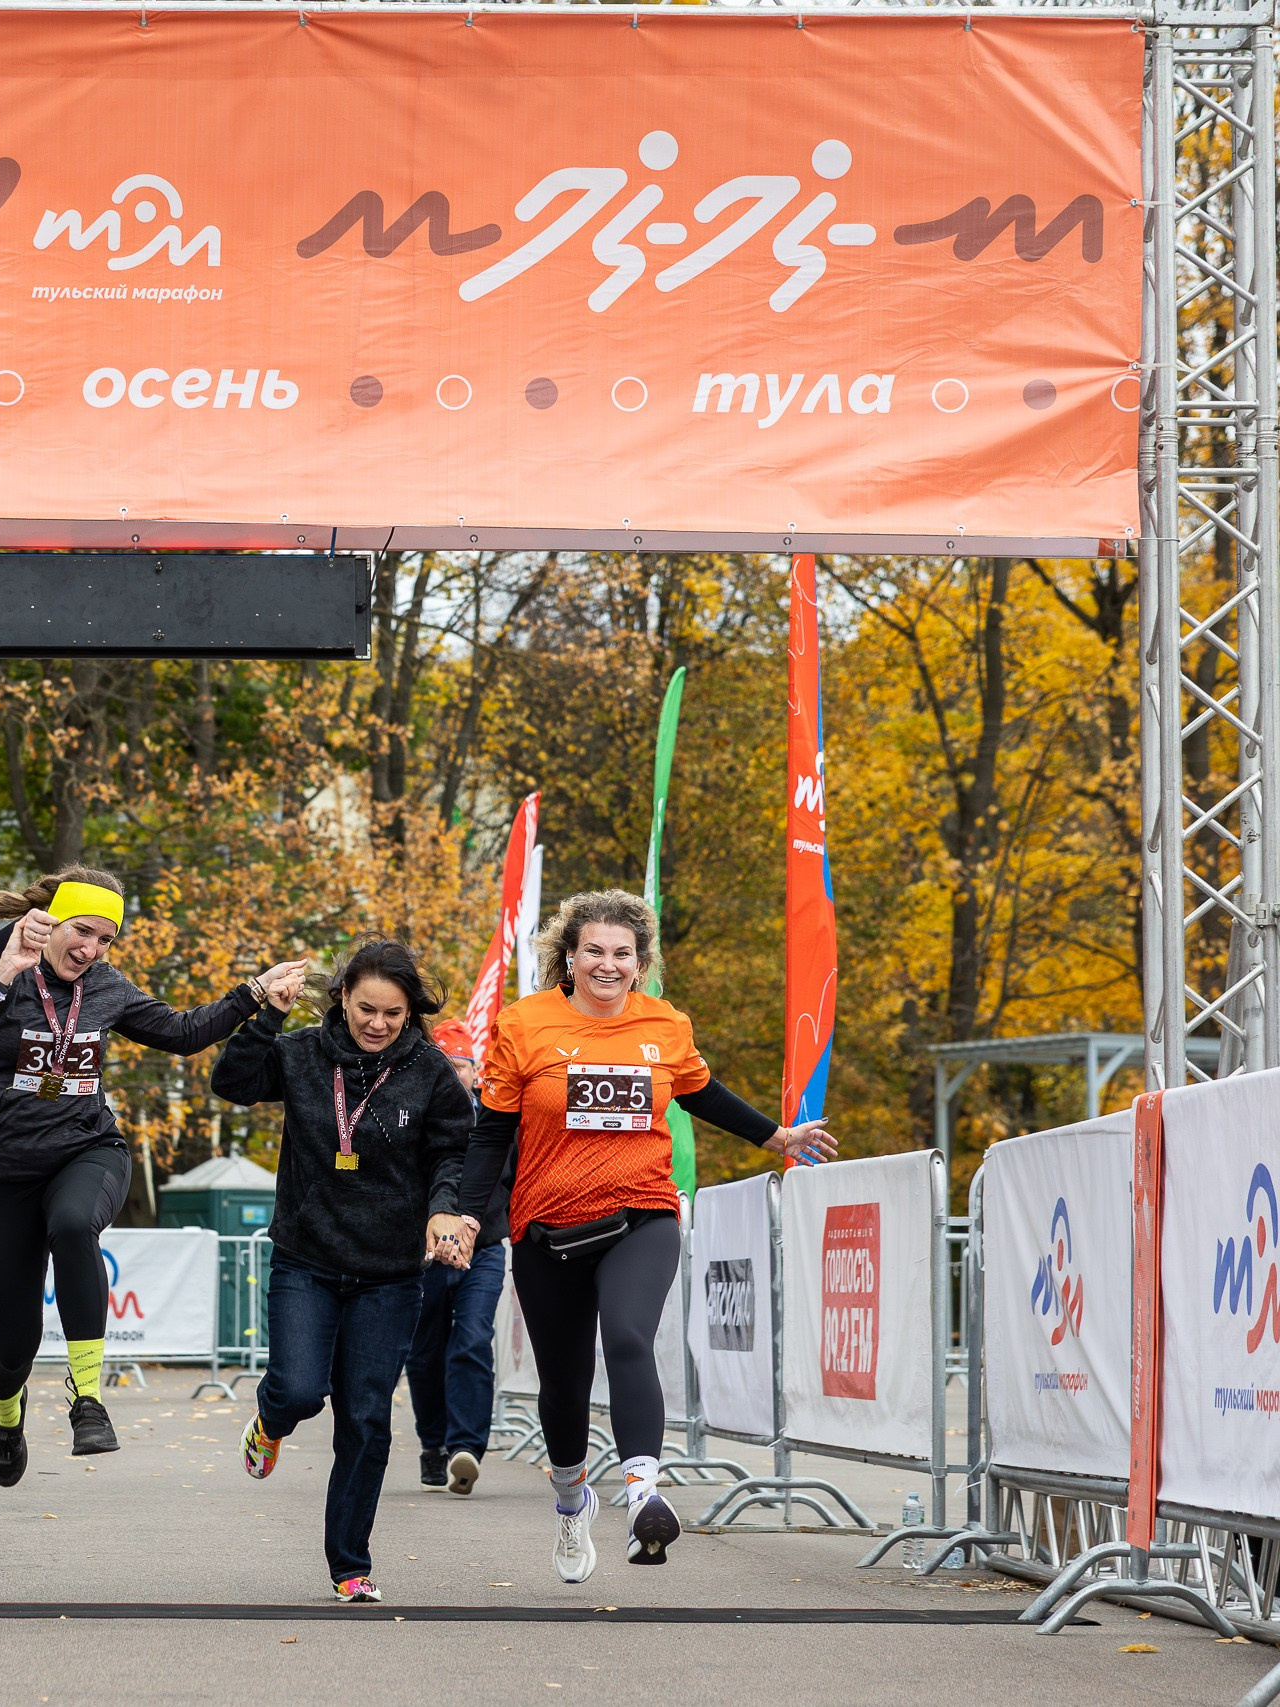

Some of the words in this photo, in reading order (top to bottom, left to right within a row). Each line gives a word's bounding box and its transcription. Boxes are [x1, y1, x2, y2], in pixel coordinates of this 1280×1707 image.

[31, 284, 128, 303] тульский
[131, 285, 224, 304] марафон
[81, 366, 300, 411] осень
[690, 371, 895, 429] тула
[575, 1079, 646, 1109] 30-5
[825, 1247, 875, 1294] ГОРДОСТЬ
[824, 1306, 849, 1373] 89.2
[850, 1307, 873, 1374] FM
[1213, 1381, 1255, 1417] тульский
[1256, 1389, 1280, 1420] мара
